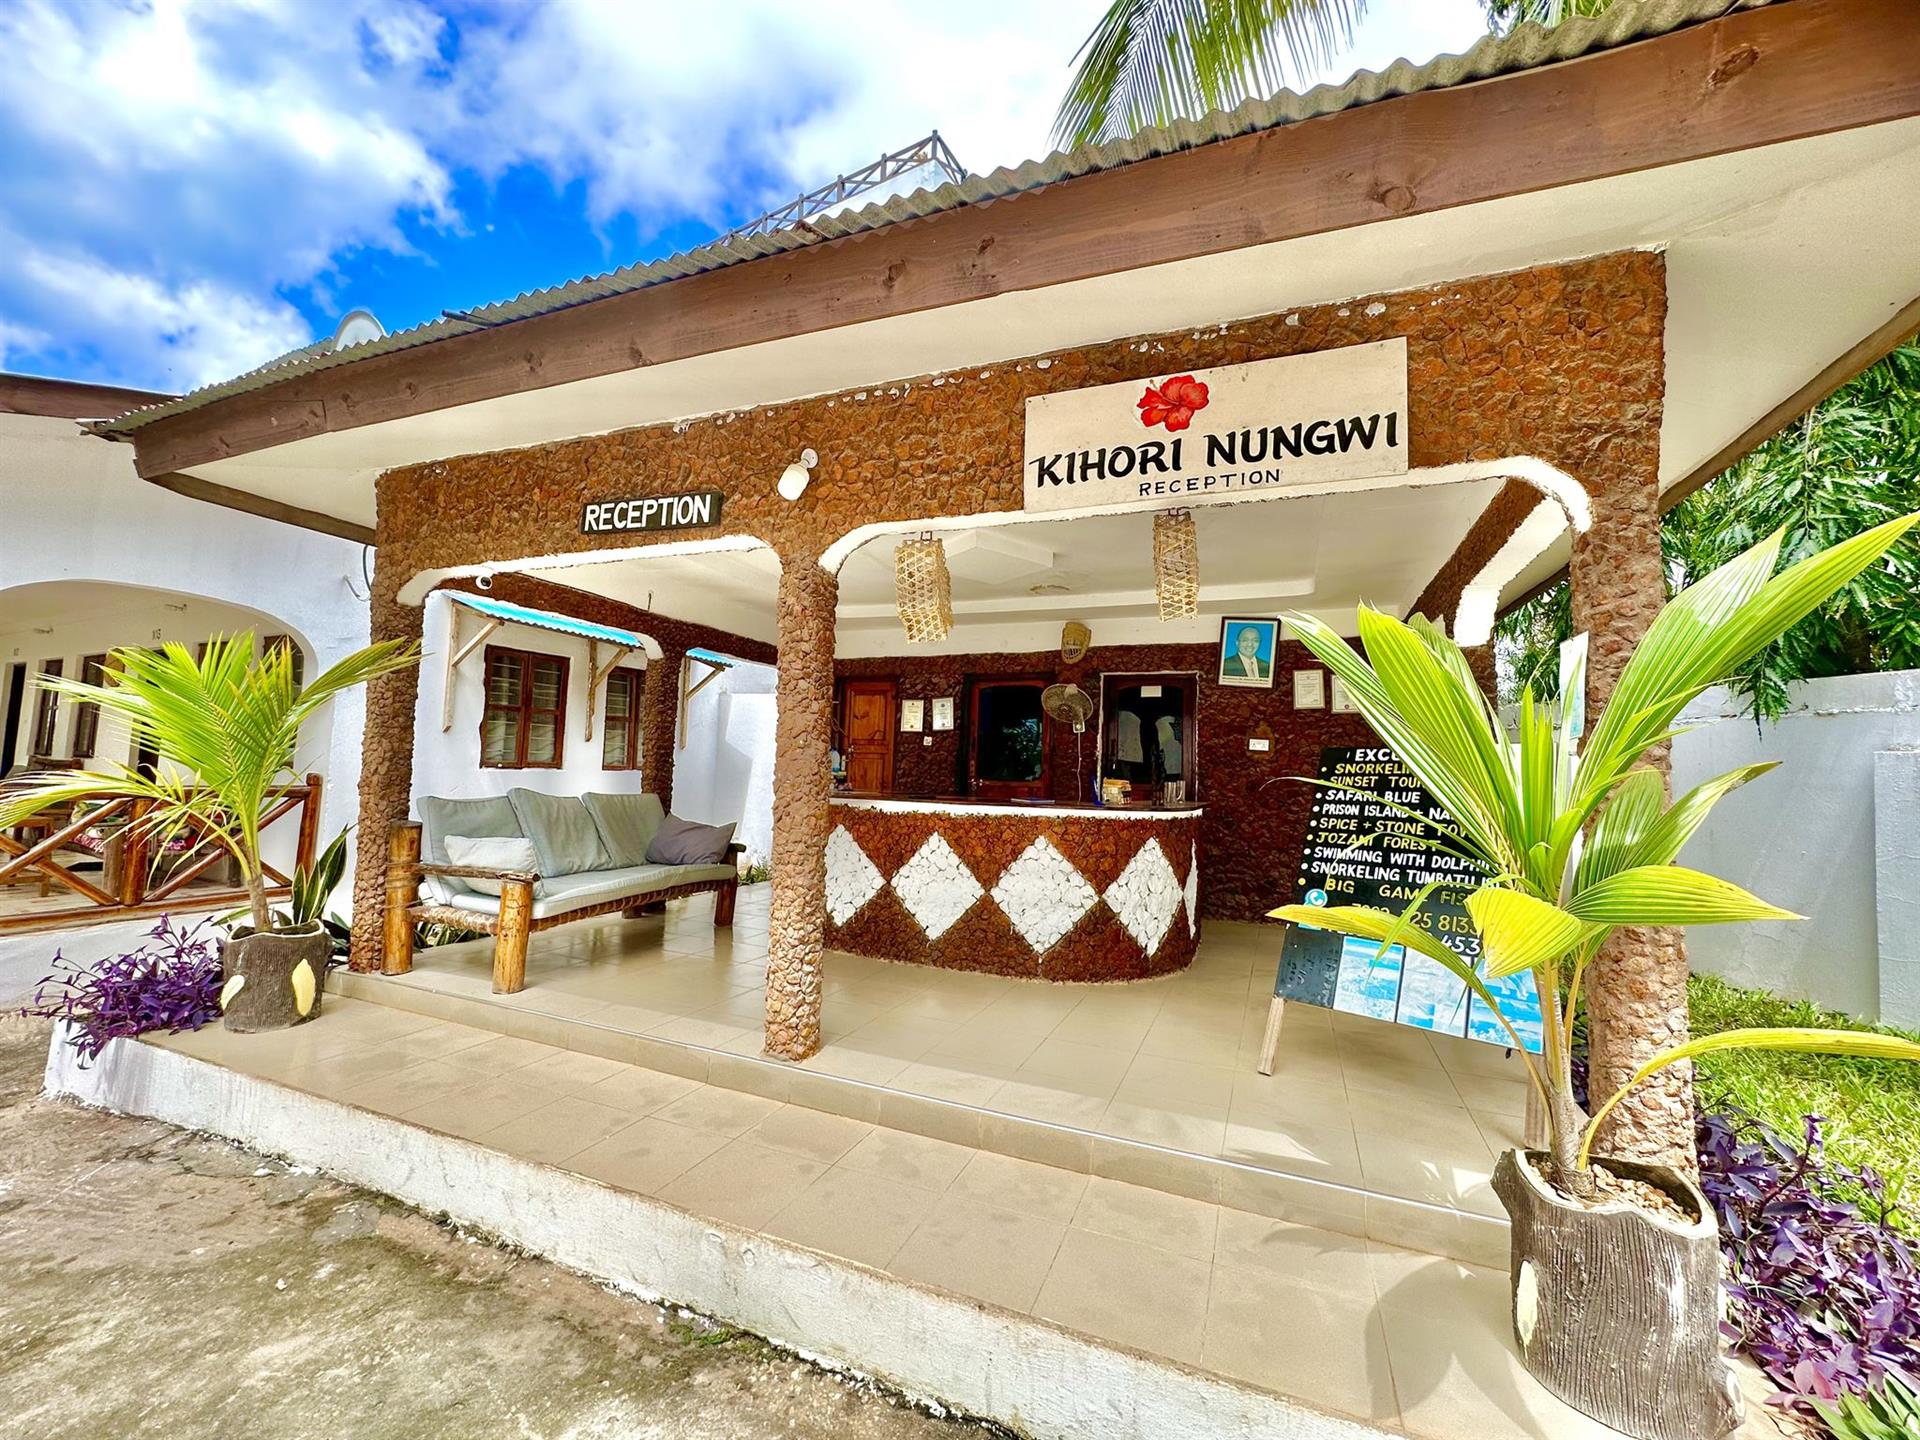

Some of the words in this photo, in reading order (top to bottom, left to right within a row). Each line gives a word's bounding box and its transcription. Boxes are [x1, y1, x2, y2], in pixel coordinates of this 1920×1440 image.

[1029, 438, 1182, 488] KIHORI
[1204, 412, 1399, 467] NUNGWI
[1139, 469, 1280, 496] RECEPTION
[584, 494, 711, 532] RECEPTION
[1330, 775, 1378, 788] SUNSET
[1325, 789, 1378, 802] SAFARI
[1384, 791, 1421, 803] BLUE
[1322, 803, 1360, 816] PRISON
[1364, 804, 1410, 818] ISLAND
[1429, 807, 1455, 820] NA
[1319, 817, 1359, 831] SPICE
[1374, 820, 1426, 836] STONE
[1383, 836, 1442, 852] FOREST
[1313, 846, 1383, 864] SWIMMING
[1390, 852, 1426, 867] WITH
[1311, 860, 1400, 882] SNORKELING
[1406, 869, 1476, 890] TUMBATU
[1326, 878, 1356, 894] BIG
[1379, 884, 1428, 902] GAM
[1440, 890, 1468, 906] FIS
[1401, 909, 1433, 929] 25
